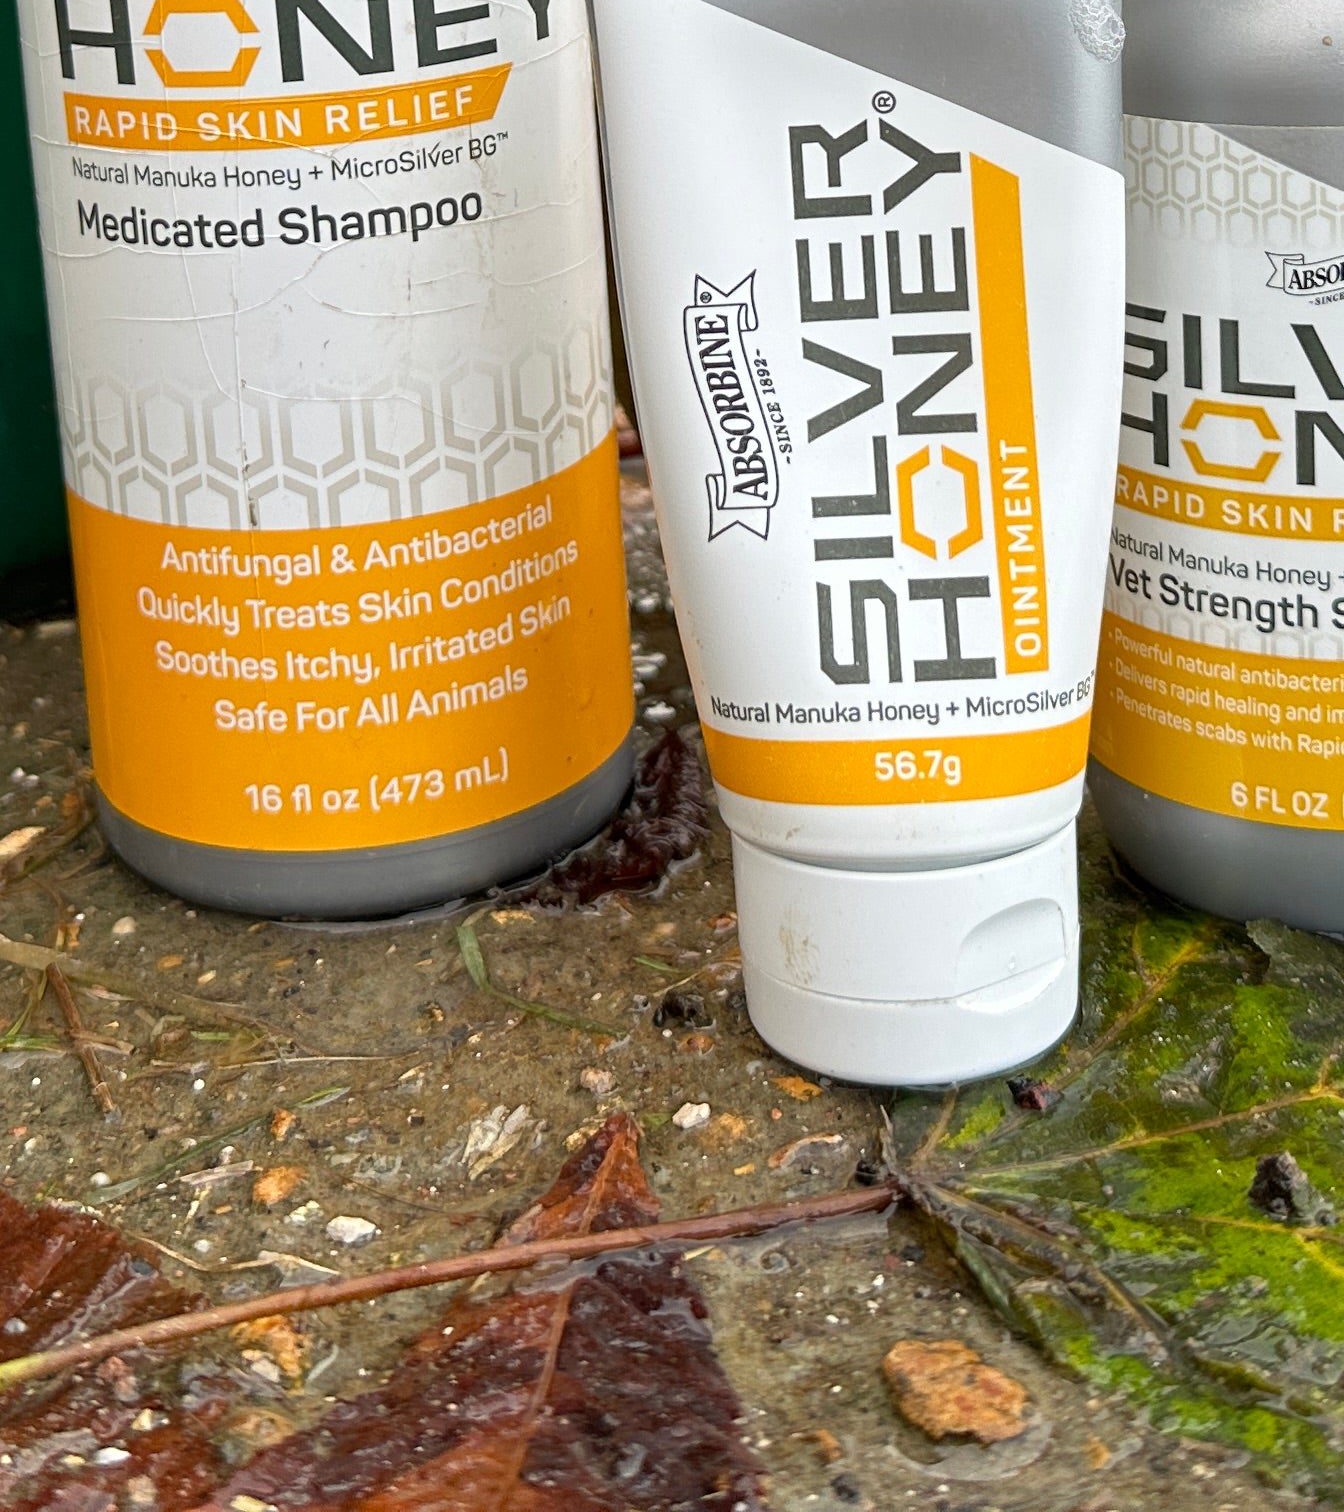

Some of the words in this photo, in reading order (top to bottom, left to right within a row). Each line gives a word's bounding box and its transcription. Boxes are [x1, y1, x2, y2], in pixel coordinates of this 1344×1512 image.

[74, 104, 178, 143] RAPID
[198, 106, 302, 143] SKIN
[324, 84, 474, 135] RELIEF
[72, 155, 130, 187] Natural
[134, 161, 217, 189] Manuka
[222, 160, 303, 192] Honey
[308, 166, 324, 182] +
[330, 141, 465, 183] MicroSilver
[76, 199, 265, 250] Medicated
[277, 190, 484, 248] Shampoo
[788, 117, 903, 686] SILVER
[1115, 474, 1205, 519] RAPID
[1221, 499, 1313, 534] SKIN
[160, 541, 322, 586] Antifungal
[330, 545, 356, 575] &
[363, 494, 553, 573] Antibacterial
[999, 439, 1043, 659] OINTMENT
[1110, 527, 1163, 561] Natural
[1168, 544, 1249, 580] Manuka
[1255, 559, 1331, 592] Honey
[136, 586, 240, 638] Quickly
[246, 598, 351, 630] Treats
[358, 588, 434, 625] Skin
[439, 538, 579, 609] Conditions
[1108, 552, 1152, 600] Vet
[1158, 572, 1319, 634] Strength
[154, 640, 279, 682] Soothes
[285, 648, 382, 686] Itchy,
[388, 613, 515, 673] Irritated
[518, 591, 572, 638] Skin
[1114, 627, 1173, 667] Powerful
[1175, 654, 1237, 682] natural
[214, 699, 288, 734] Safe
[295, 699, 351, 734] For
[356, 693, 400, 726] All
[405, 663, 529, 723] Animals
[710, 694, 770, 724] Natural
[775, 700, 862, 724] Manuka
[867, 700, 941, 726] Honey
[945, 702, 960, 718] +
[965, 687, 1075, 719] MicroSilver
[1114, 656, 1168, 696] Delivers
[1169, 682, 1211, 708] rapid
[1214, 692, 1282, 725] healing
[1284, 703, 1322, 724] and
[1115, 686, 1193, 734] Penetrates
[1195, 720, 1249, 747] scabs
[1250, 729, 1294, 754] with
[244, 782, 283, 814] 16
[291, 783, 314, 814] fl
[321, 787, 360, 813] oz
[369, 767, 447, 814] (473
[453, 746, 510, 793] mL)
[873, 750, 963, 786] 56.7g
[1230, 780, 1250, 809] 6
[1254, 788, 1287, 817] FL
[1291, 789, 1330, 818] OZ
